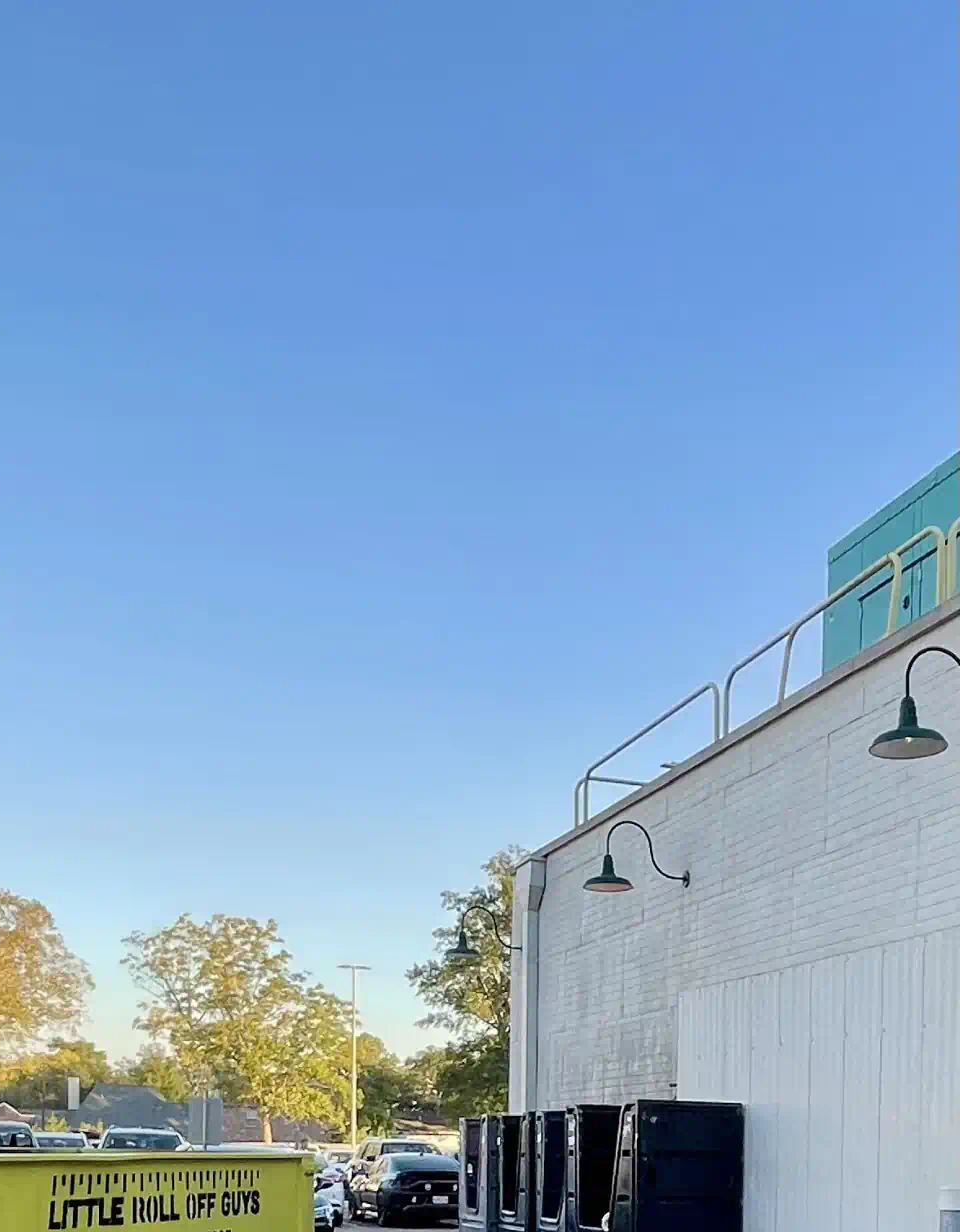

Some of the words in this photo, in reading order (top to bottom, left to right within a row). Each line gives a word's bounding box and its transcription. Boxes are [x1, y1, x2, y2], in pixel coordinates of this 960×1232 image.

[48, 1197, 124, 1230] LITTLE
[132, 1194, 180, 1224] ROLL
[186, 1192, 216, 1220] OFF
[221, 1190, 260, 1217] GUYS
